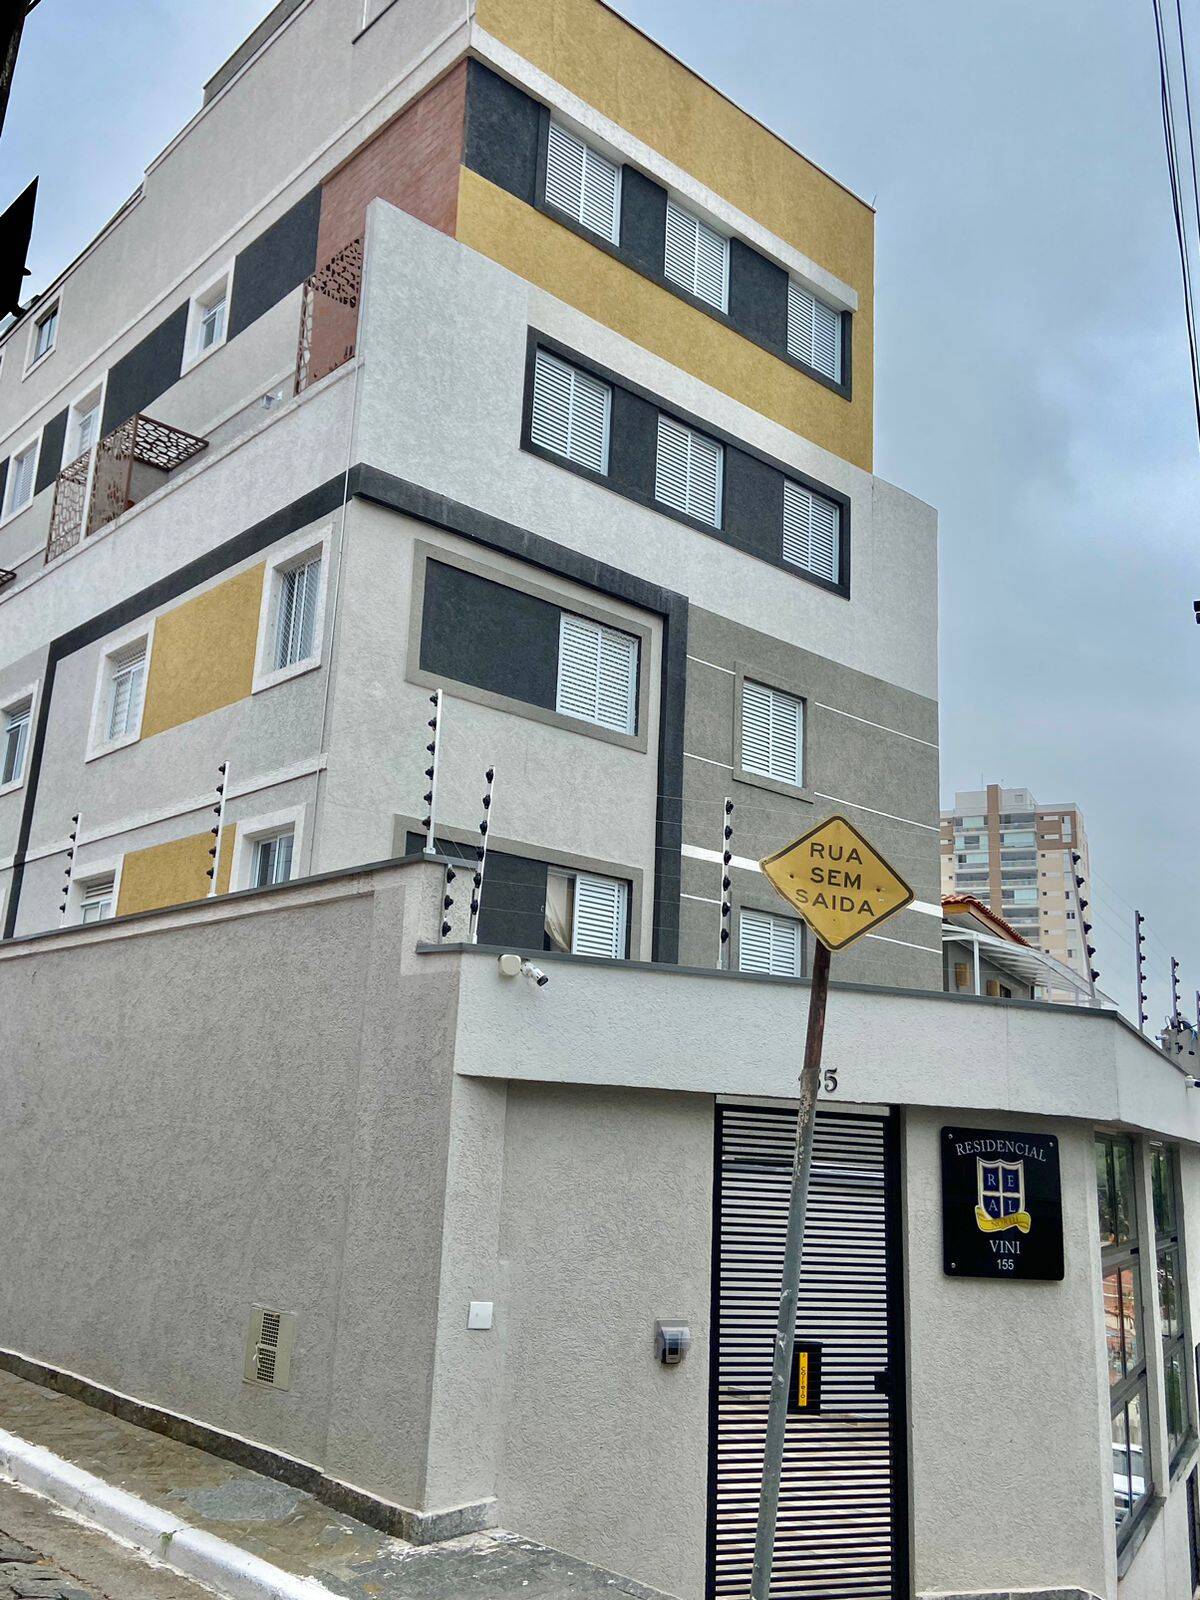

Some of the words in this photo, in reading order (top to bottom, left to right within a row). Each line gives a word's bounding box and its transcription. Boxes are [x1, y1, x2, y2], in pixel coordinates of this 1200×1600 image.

[810, 842, 863, 865] RUA
[810, 867, 862, 890] SEM
[795, 889, 875, 917] SAIDA
[955, 1139, 1047, 1162] RESIDENCIAL
[988, 1173, 997, 1186] R
[1007, 1174, 1015, 1187] E
[988, 1199, 999, 1212] A
[1008, 1200, 1016, 1213] L
[989, 1239, 1021, 1254] VINI
[997, 1258, 1015, 1270] 155
